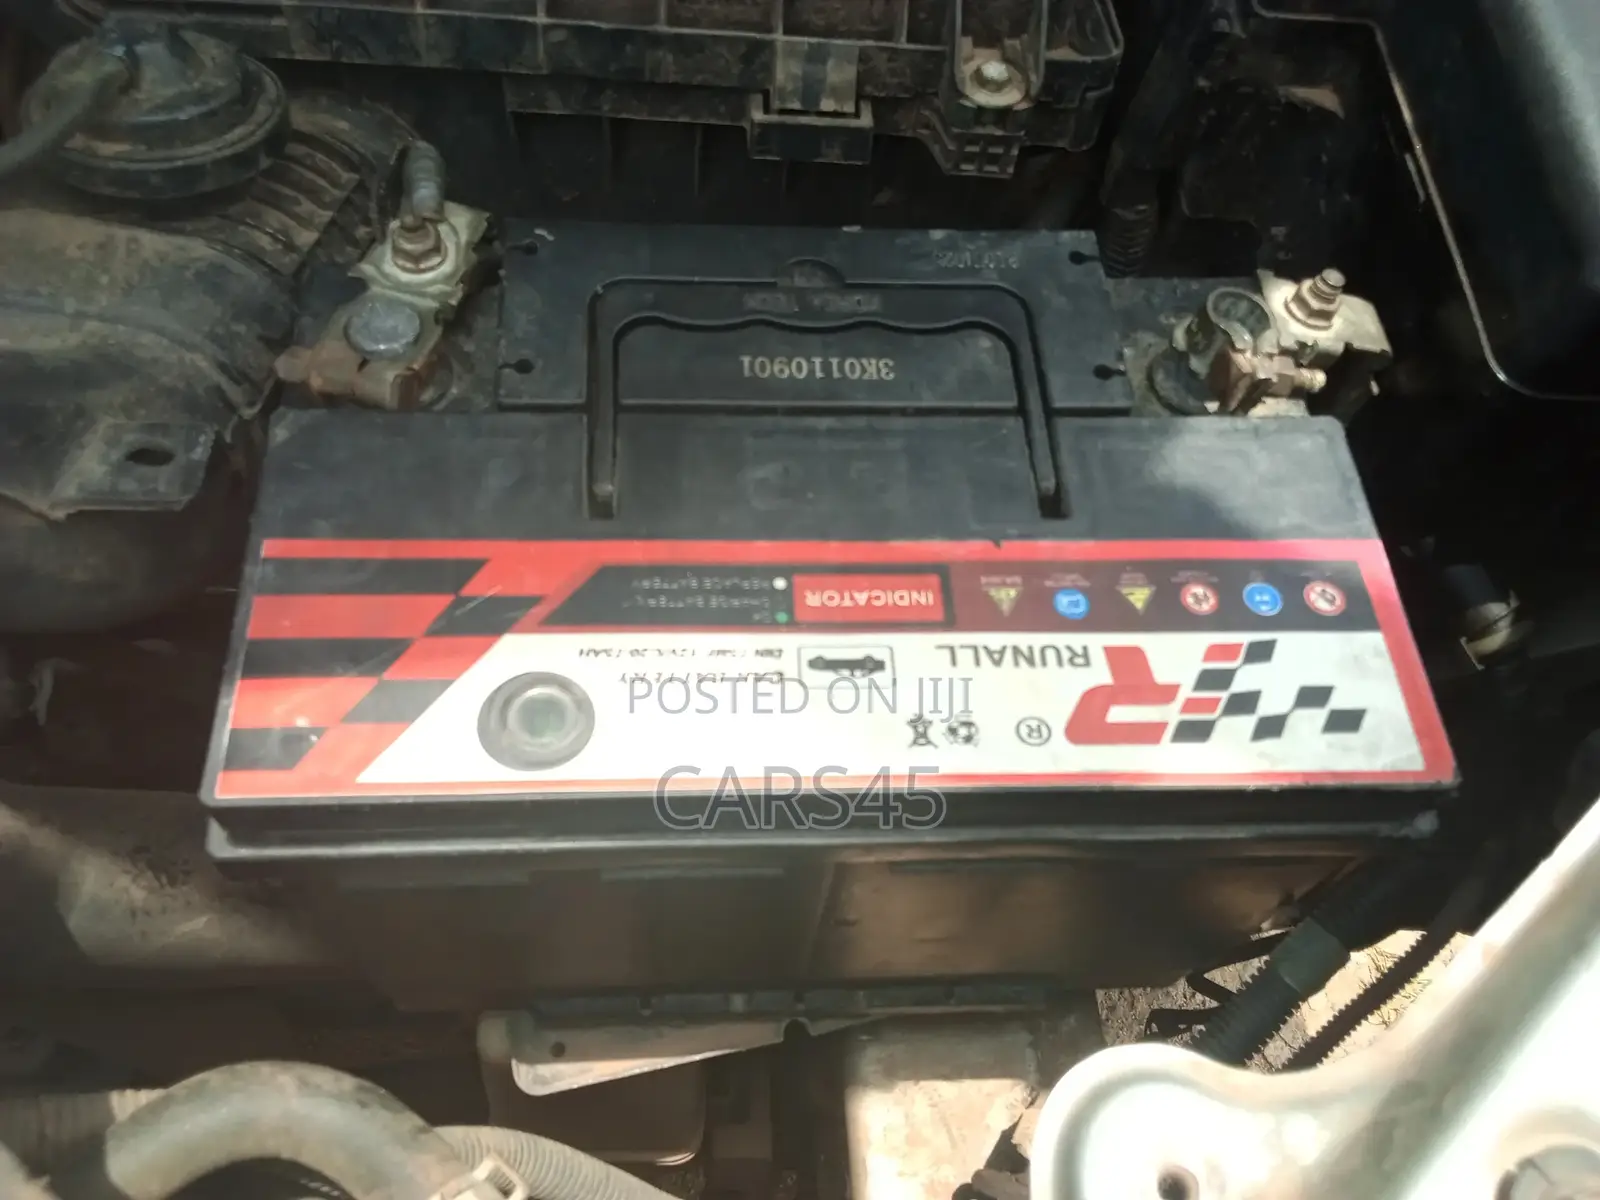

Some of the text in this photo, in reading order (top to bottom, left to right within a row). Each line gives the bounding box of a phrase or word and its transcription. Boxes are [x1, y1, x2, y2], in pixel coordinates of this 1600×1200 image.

[739, 355, 896, 380] 3K0110901
[804, 589, 935, 607] INDICATOR
[934, 644, 1092, 668] RUNALL
